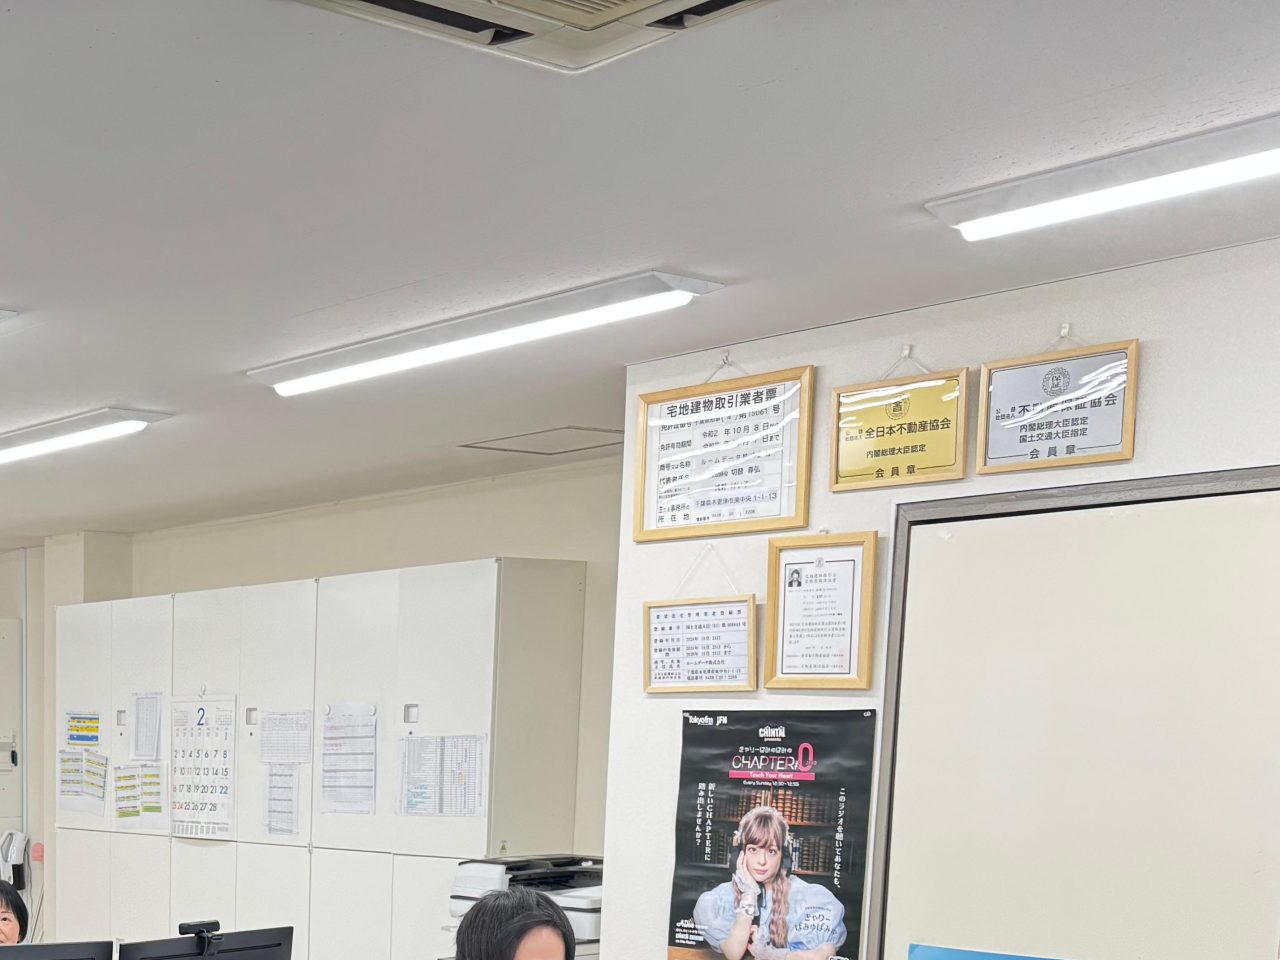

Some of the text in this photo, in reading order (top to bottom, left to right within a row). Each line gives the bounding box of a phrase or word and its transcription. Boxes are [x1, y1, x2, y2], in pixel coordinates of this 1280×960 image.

[666, 387, 778, 418] 宅地建物取引業者票
[865, 417, 952, 440] 全日本不動産協会
[1020, 417, 1089, 433] 内閣総理大臣認定
[1019, 427, 1088, 443] 国土交通大臣指定
[866, 443, 927, 458] 内閣総理大臣認定
[1029, 444, 1076, 459] 会員章
[875, 464, 916, 478] 会員章
[196, 707, 206, 726] 2
